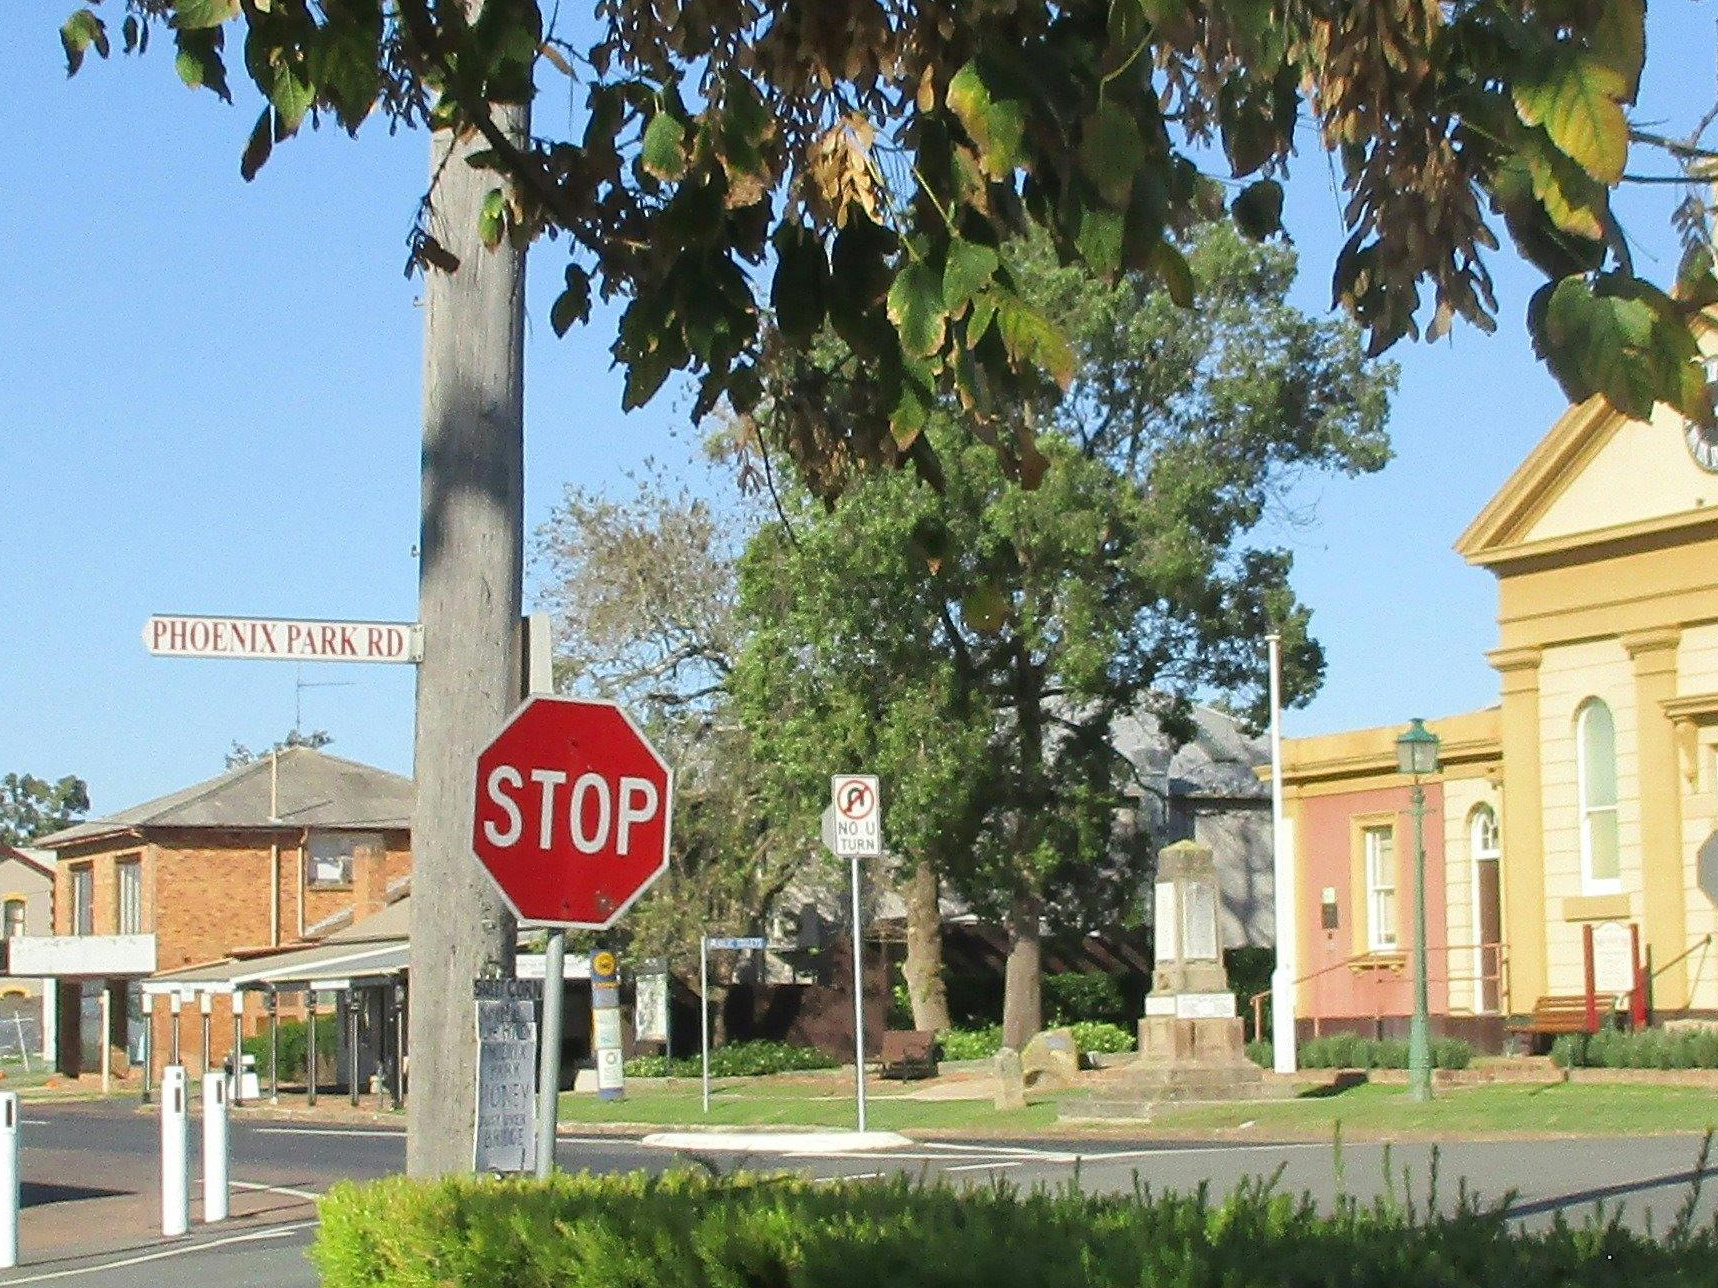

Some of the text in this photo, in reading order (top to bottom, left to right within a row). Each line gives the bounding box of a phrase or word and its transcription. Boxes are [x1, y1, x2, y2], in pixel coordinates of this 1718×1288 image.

[152, 618, 404, 658] PHOENIX PARK RD
[483, 764, 658, 857] STOP
[838, 821, 875, 835] NO U
[841, 838, 875, 850] TURN
